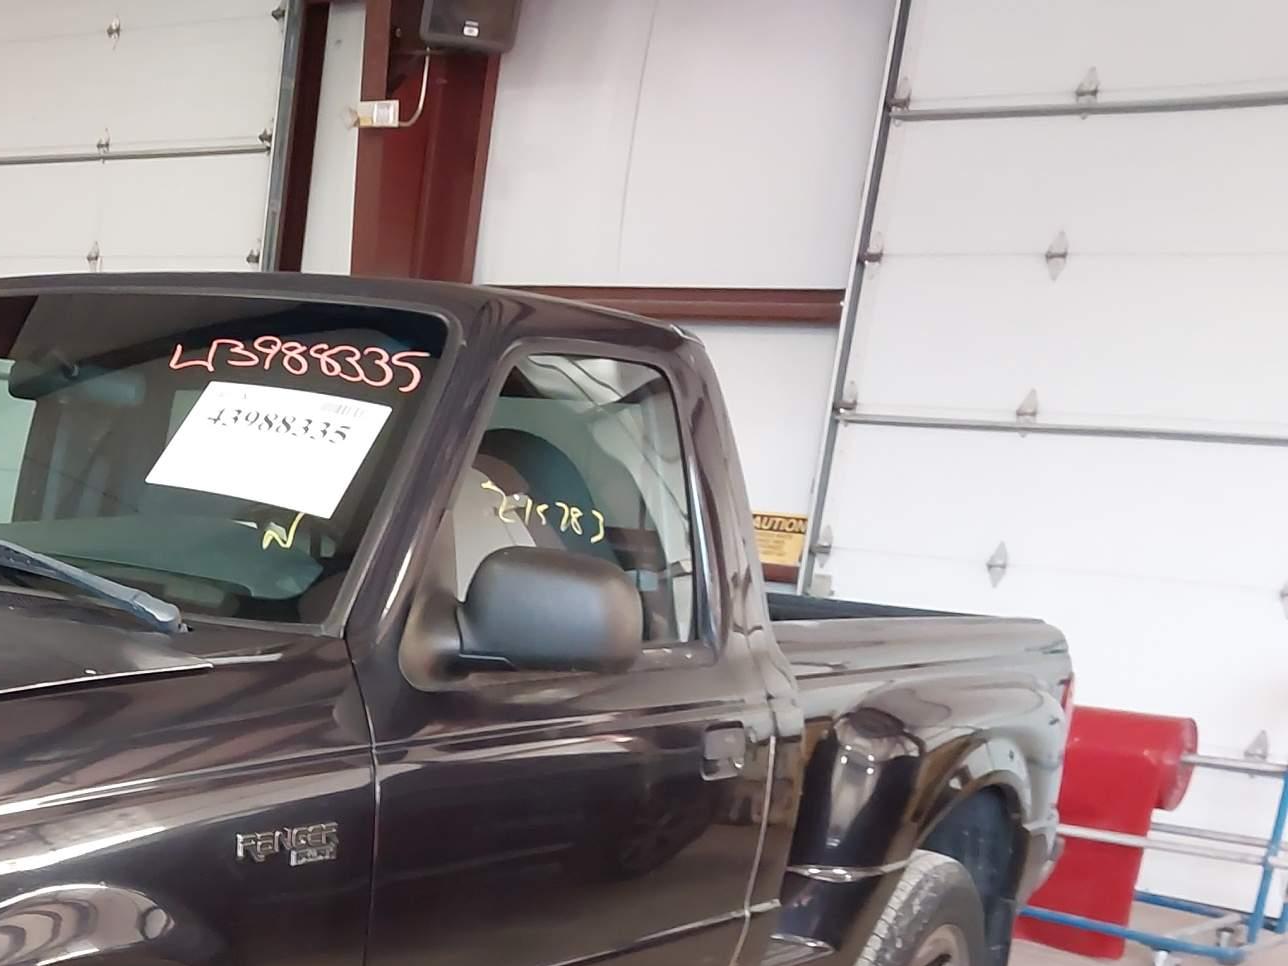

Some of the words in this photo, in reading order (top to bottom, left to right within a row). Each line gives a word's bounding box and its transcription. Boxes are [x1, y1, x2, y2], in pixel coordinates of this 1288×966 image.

[169, 336, 431, 392] 43988335
[207, 407, 352, 444] 43988335
[753, 515, 808, 533] AUTION
[236, 822, 339, 863] RANGER
